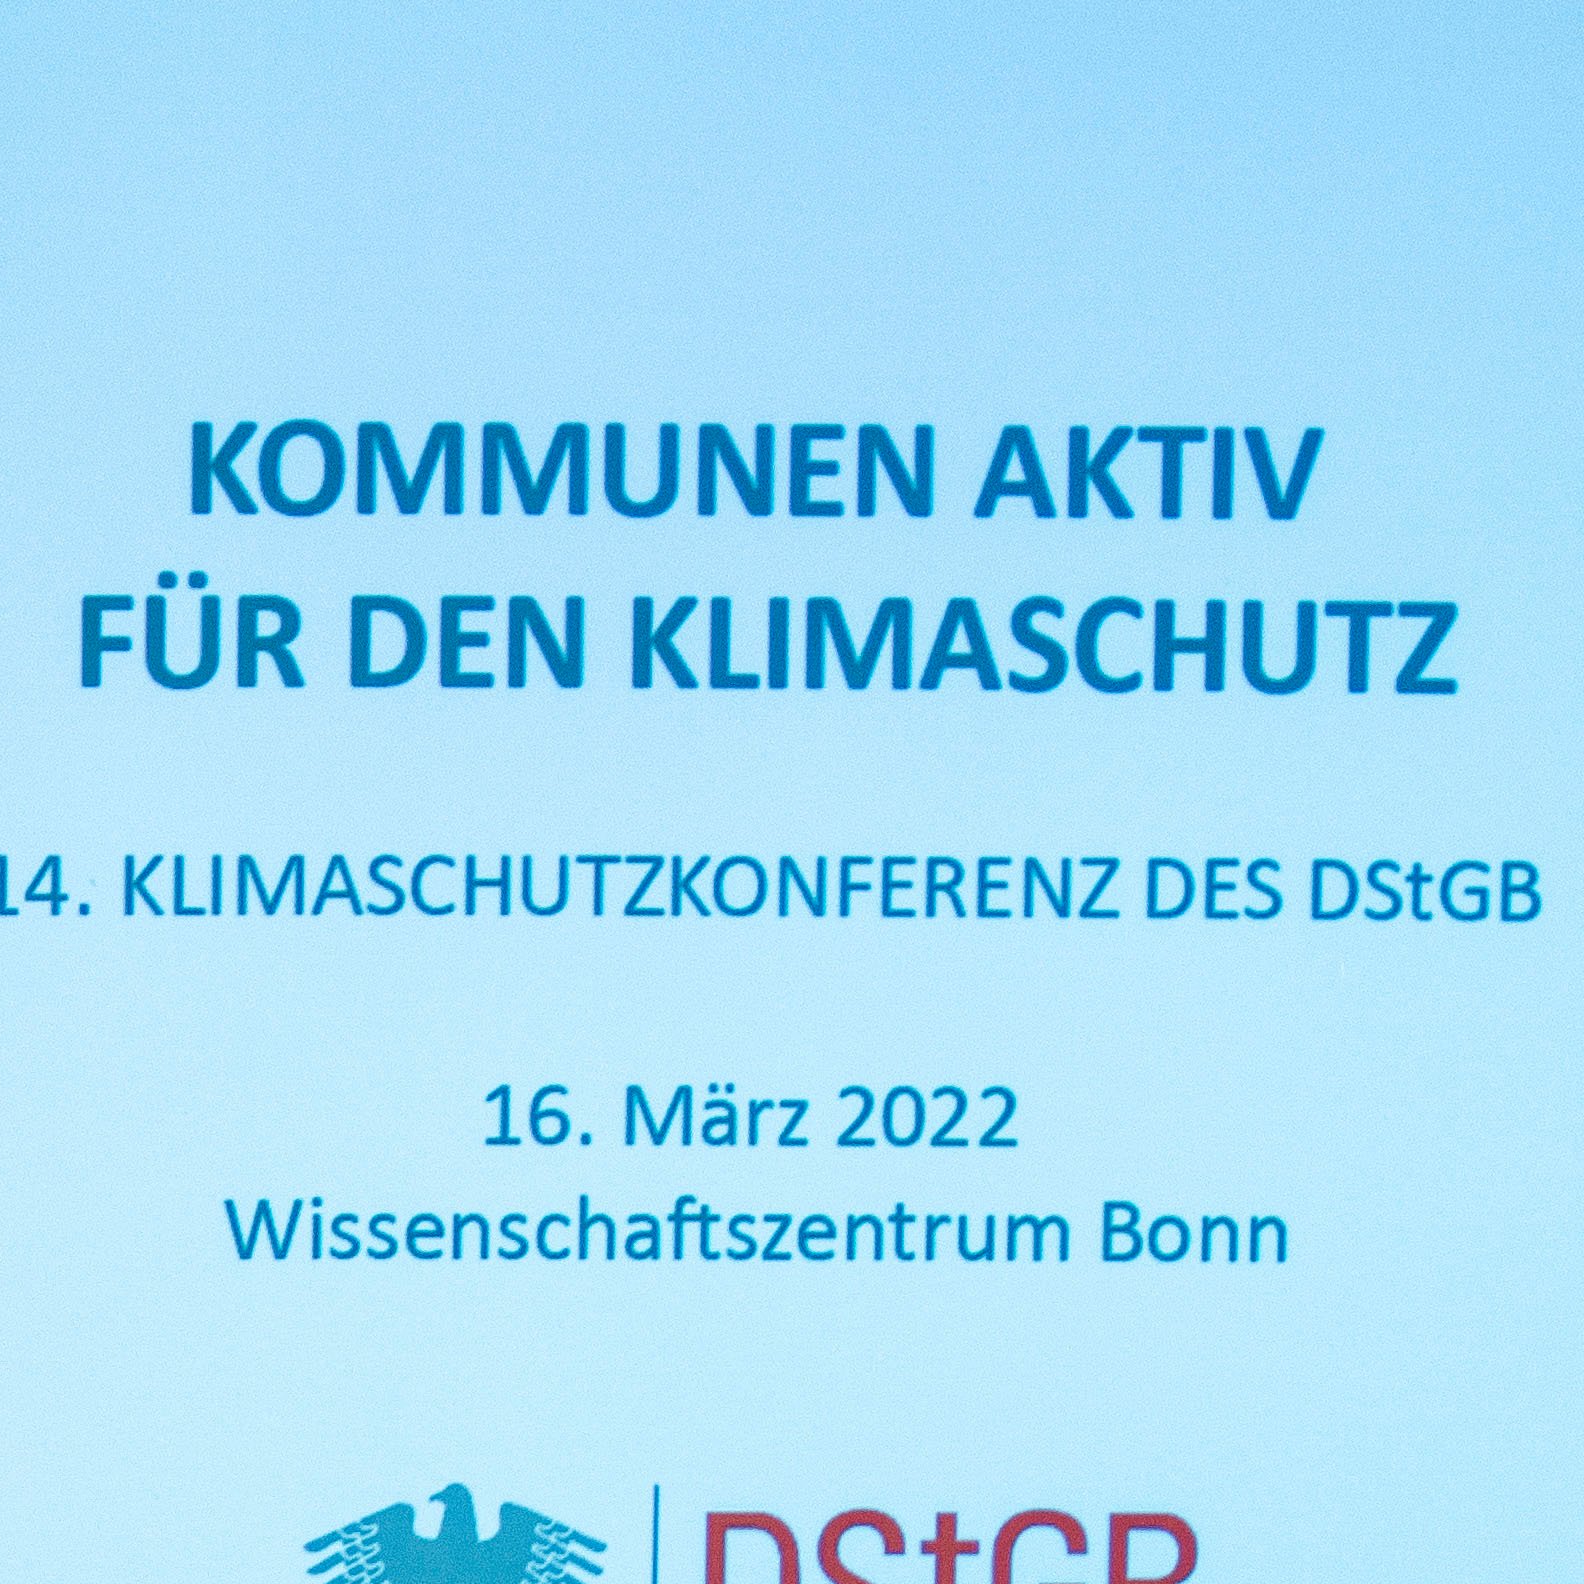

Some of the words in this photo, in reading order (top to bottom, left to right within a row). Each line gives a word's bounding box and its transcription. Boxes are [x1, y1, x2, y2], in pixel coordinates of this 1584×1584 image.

[192, 419, 933, 518] KOMMUNEN
[974, 425, 1324, 520] AKTIV
[81, 571, 305, 690] FÜR
[350, 595, 584, 688] DEN
[632, 596, 1458, 695] KLIMASCHUTZ
[124, 854, 1120, 919] KLIMASCHUTZKONFERENZ
[1147, 857, 1283, 920] DES
[1311, 859, 1542, 922] DStGB
[485, 1084, 592, 1146] 16.
[625, 1083, 809, 1147] März
[837, 1085, 1017, 1148] 2022
[224, 1194, 1070, 1262] Wissenschaftszentrum
[1102, 1200, 1287, 1263] Bonn
